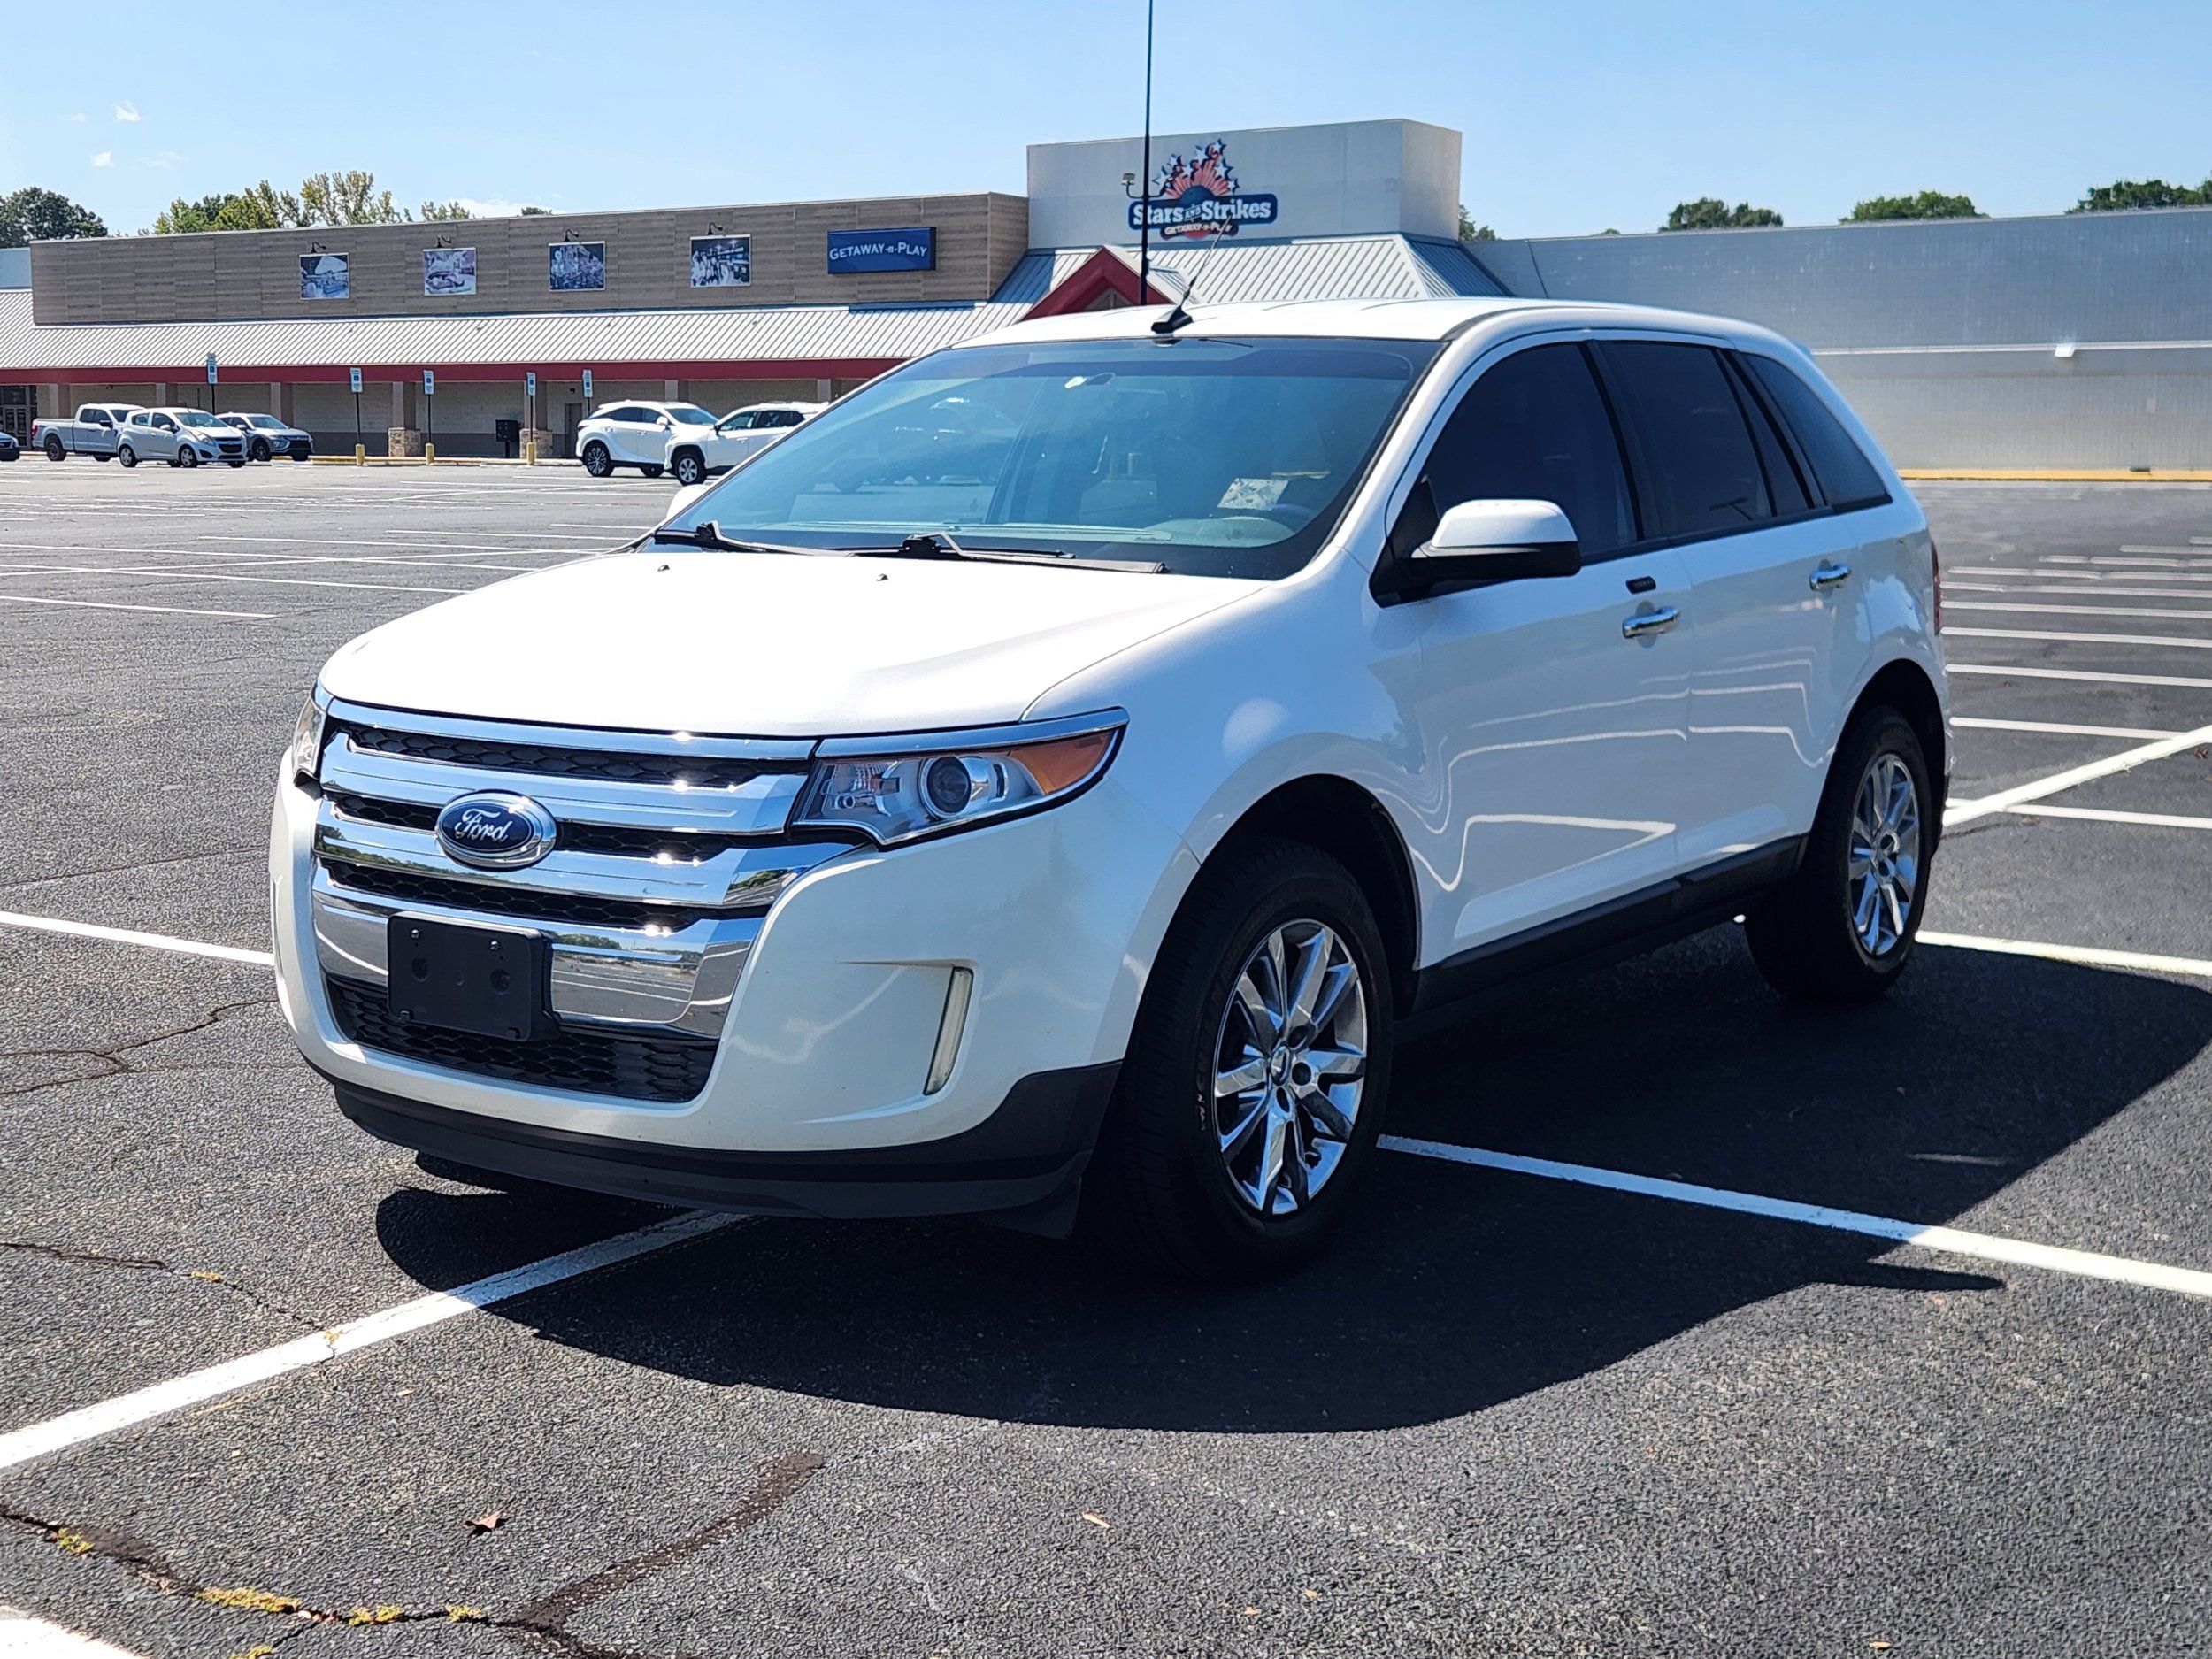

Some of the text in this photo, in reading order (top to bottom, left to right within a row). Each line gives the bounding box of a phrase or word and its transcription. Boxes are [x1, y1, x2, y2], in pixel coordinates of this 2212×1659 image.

[1133, 204, 1184, 225] Stars
[1202, 198, 1271, 220] Strikes
[454, 808, 513, 842] Ford
